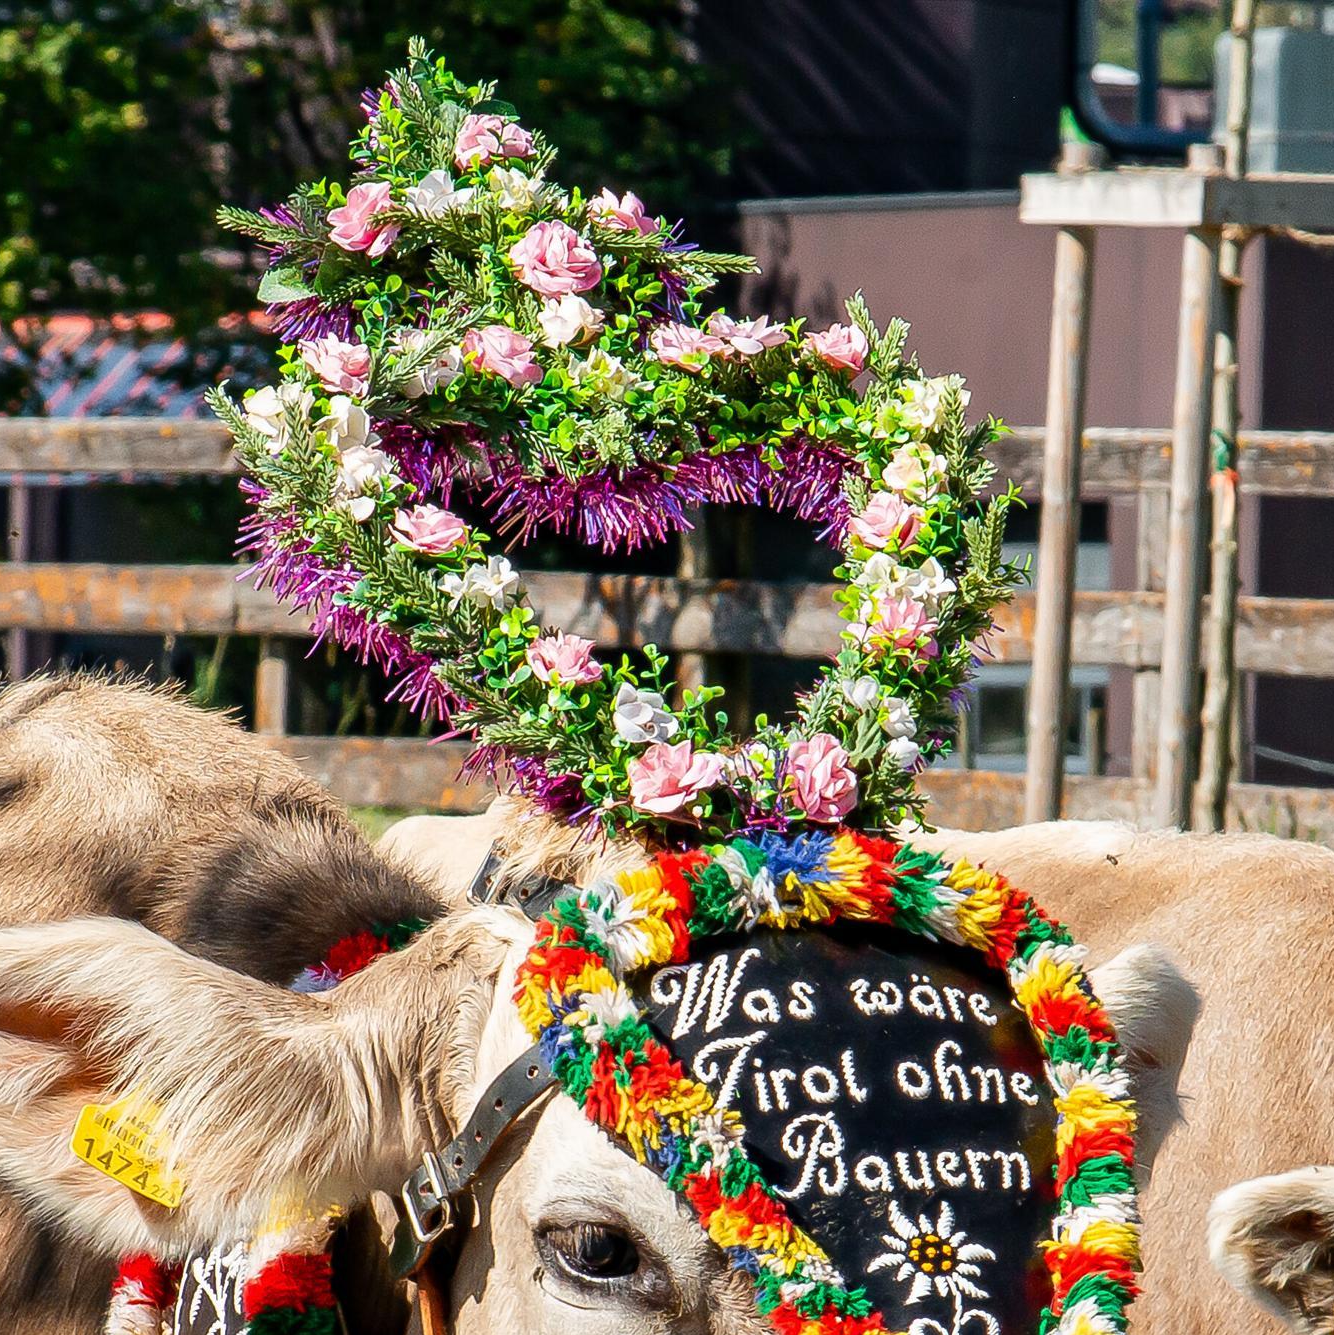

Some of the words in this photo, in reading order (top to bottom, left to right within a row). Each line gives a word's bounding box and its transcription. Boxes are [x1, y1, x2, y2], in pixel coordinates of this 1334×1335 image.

[650, 948, 815, 1041] Was
[850, 973, 997, 1026] wäre
[693, 1030, 867, 1112] Tirol
[897, 1039, 1039, 1106] ohne
[84, 1138, 149, 1191] 1474
[771, 1110, 1032, 1199] Bauern
